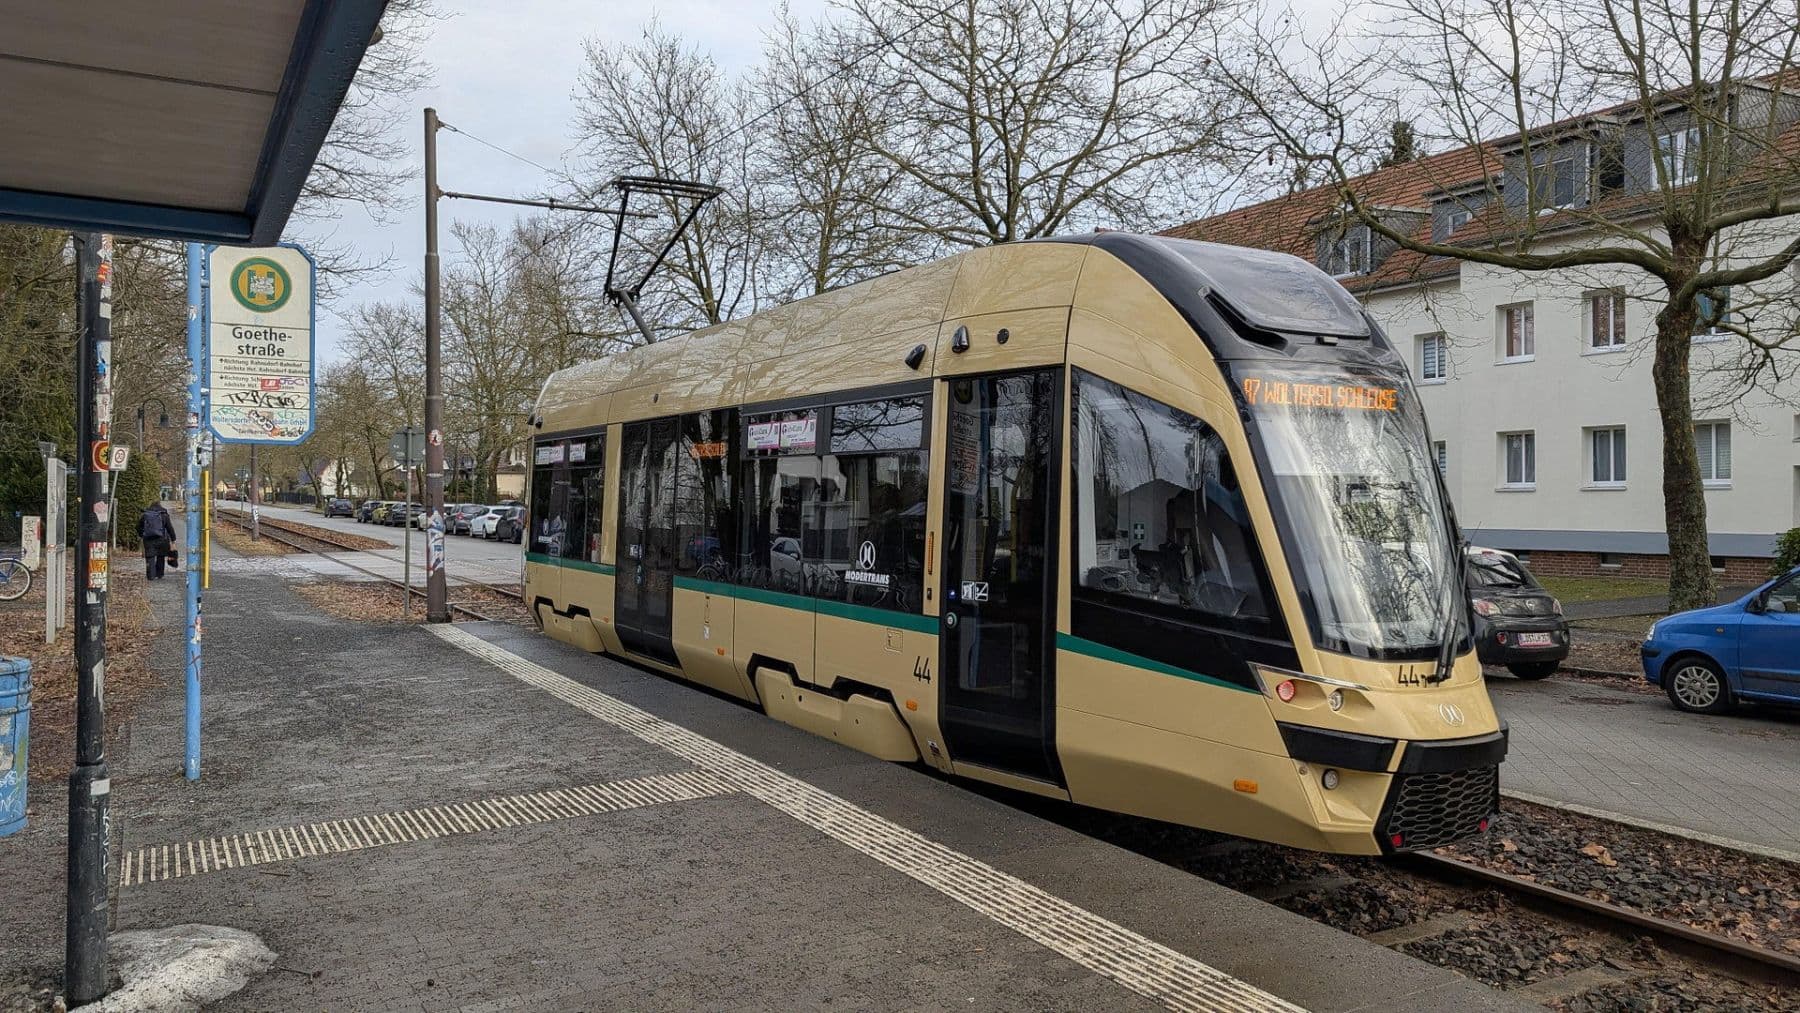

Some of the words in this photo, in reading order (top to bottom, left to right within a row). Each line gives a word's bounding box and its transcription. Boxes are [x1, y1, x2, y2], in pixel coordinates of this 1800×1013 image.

[232, 326, 293, 342] Goethe-
[237, 343, 285, 357] straße
[1337, 385, 1397, 410] SCHLEUSE
[845, 570, 889, 584] MODERTRANS
[913, 656, 931, 684] 44
[1398, 665, 1419, 687] 44
